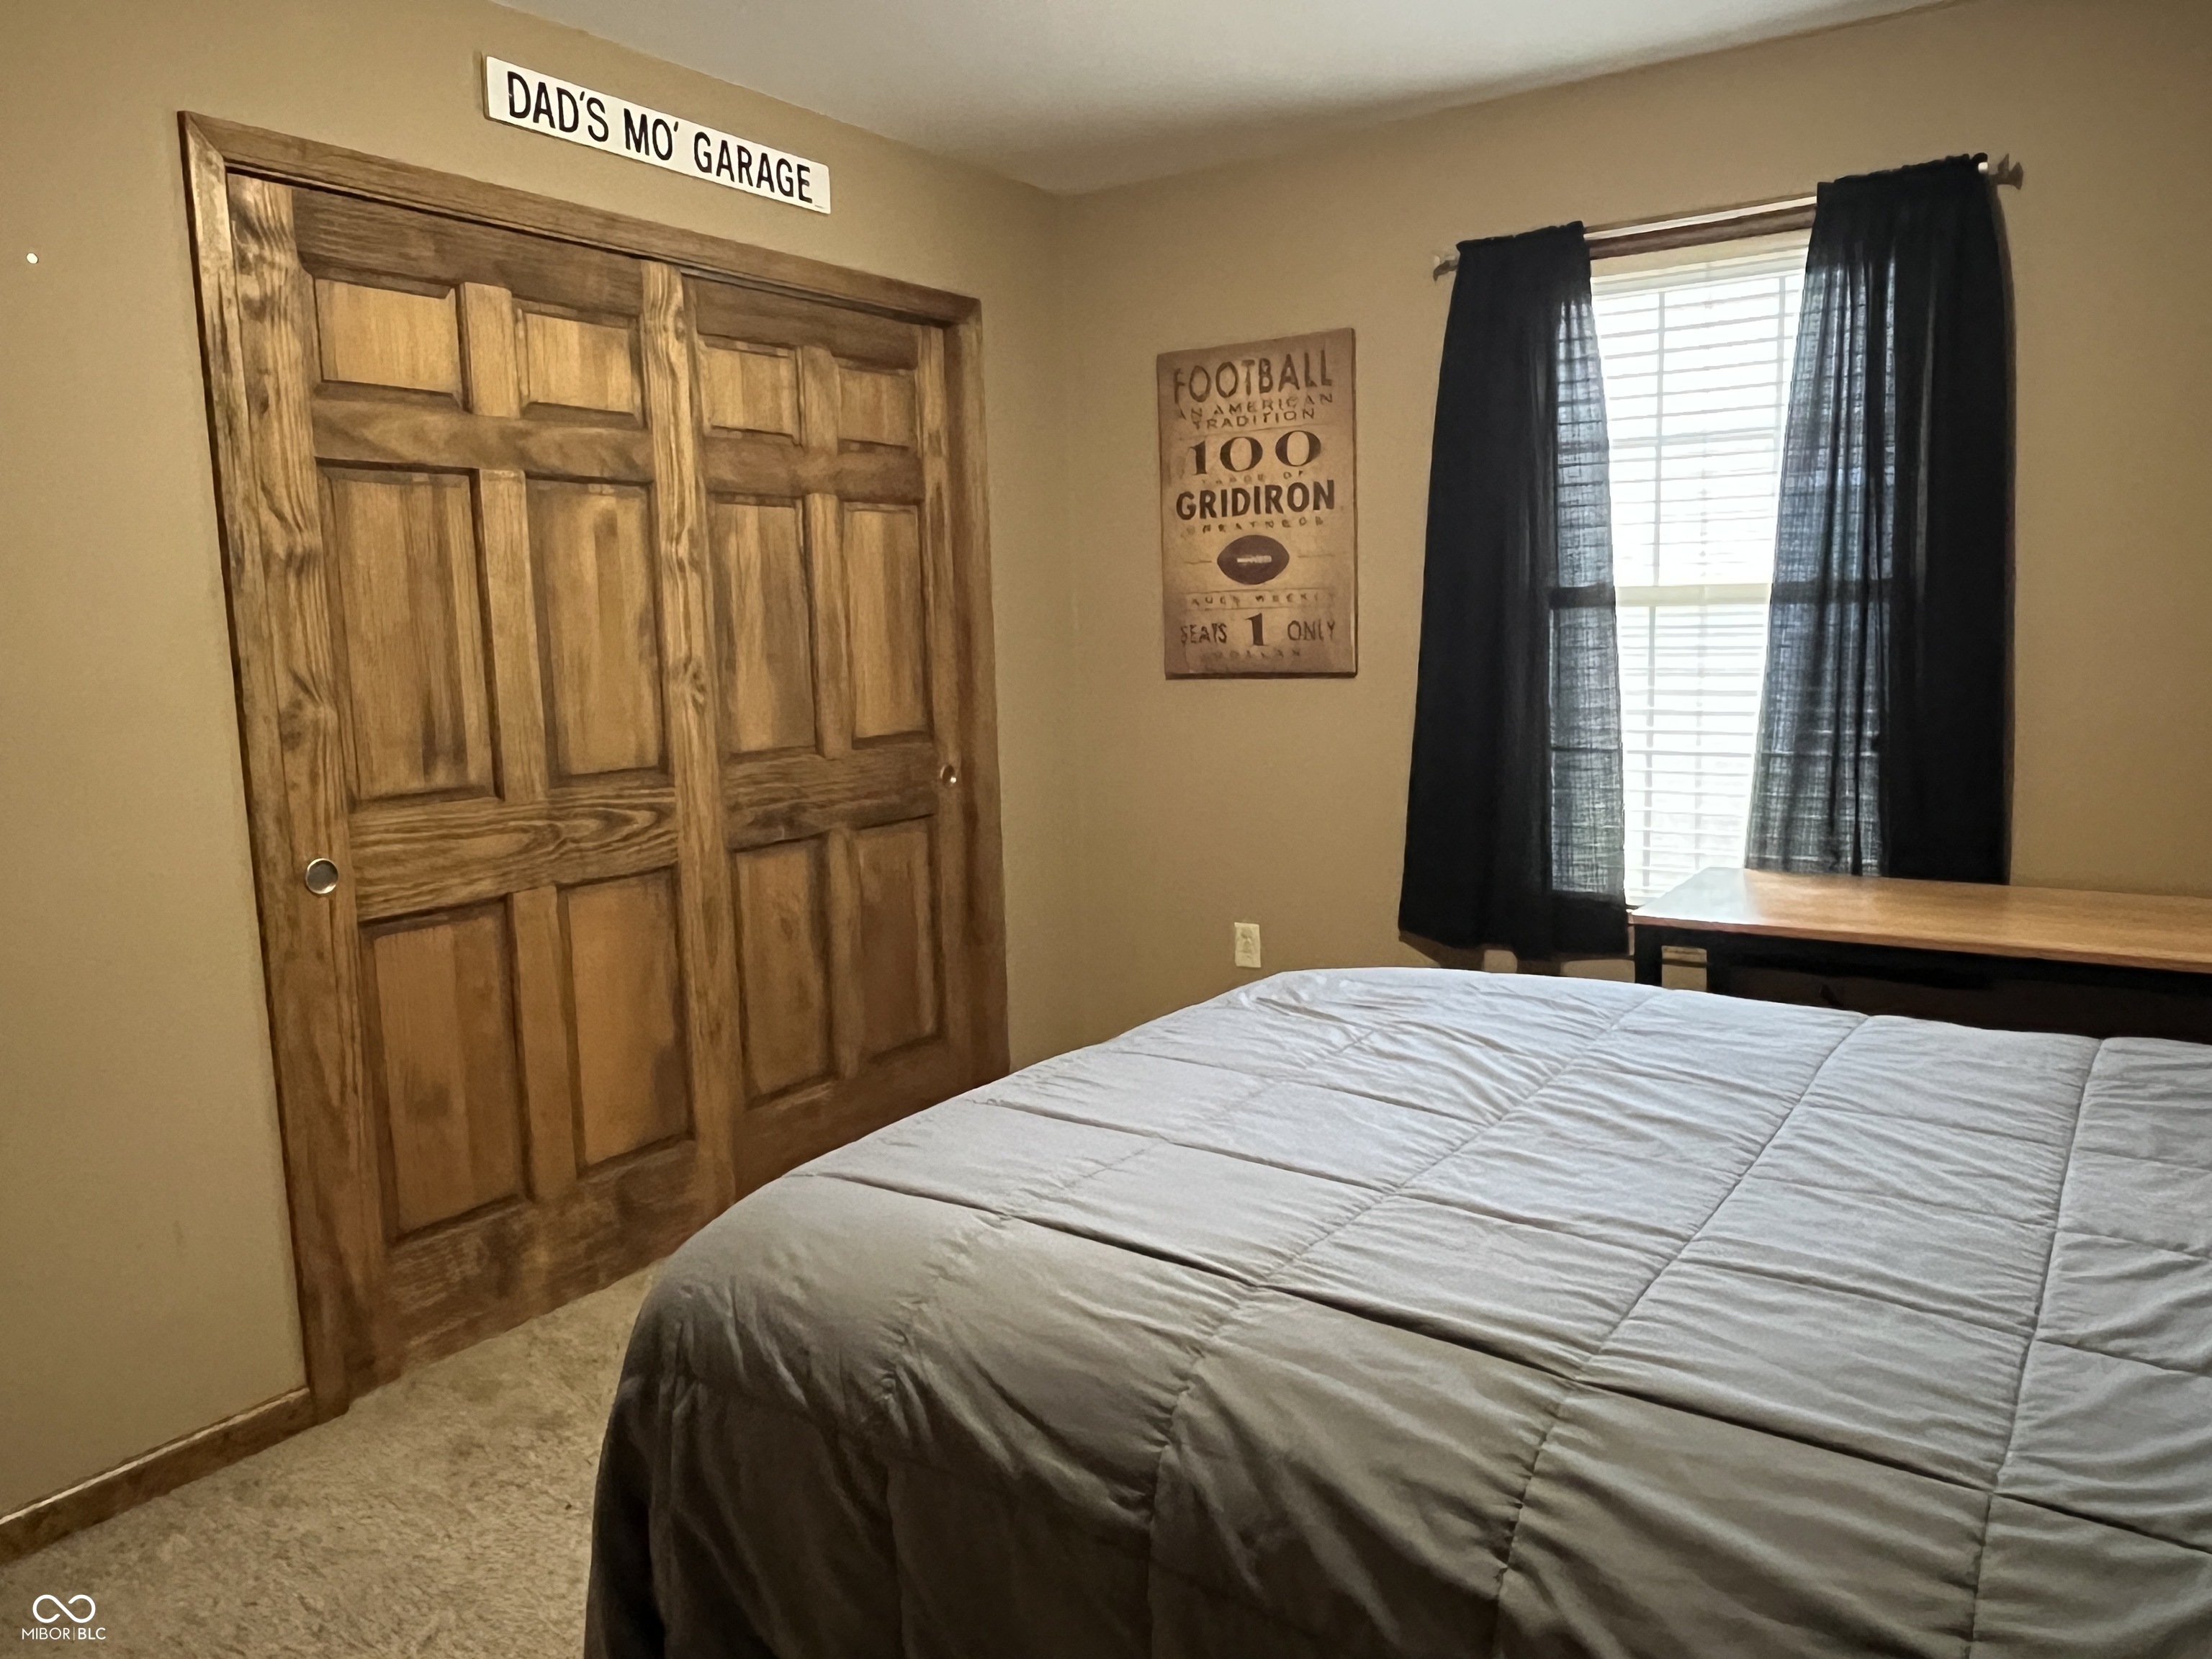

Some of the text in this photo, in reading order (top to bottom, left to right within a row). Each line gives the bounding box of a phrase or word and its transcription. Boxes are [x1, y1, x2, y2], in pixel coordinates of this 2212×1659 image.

[508, 71, 813, 204] DAD'S MO' GARAGE
[1172, 349, 1334, 404] FOOTBALL
[1192, 408, 1316, 430] TRADITION
[1213, 393, 1334, 415] AMERICAN
[1189, 430, 1322, 476] 100
[1176, 479, 1335, 521] GRIDIRON
[1244, 612, 1267, 647] 1
[1287, 620, 1336, 642] ONLY
